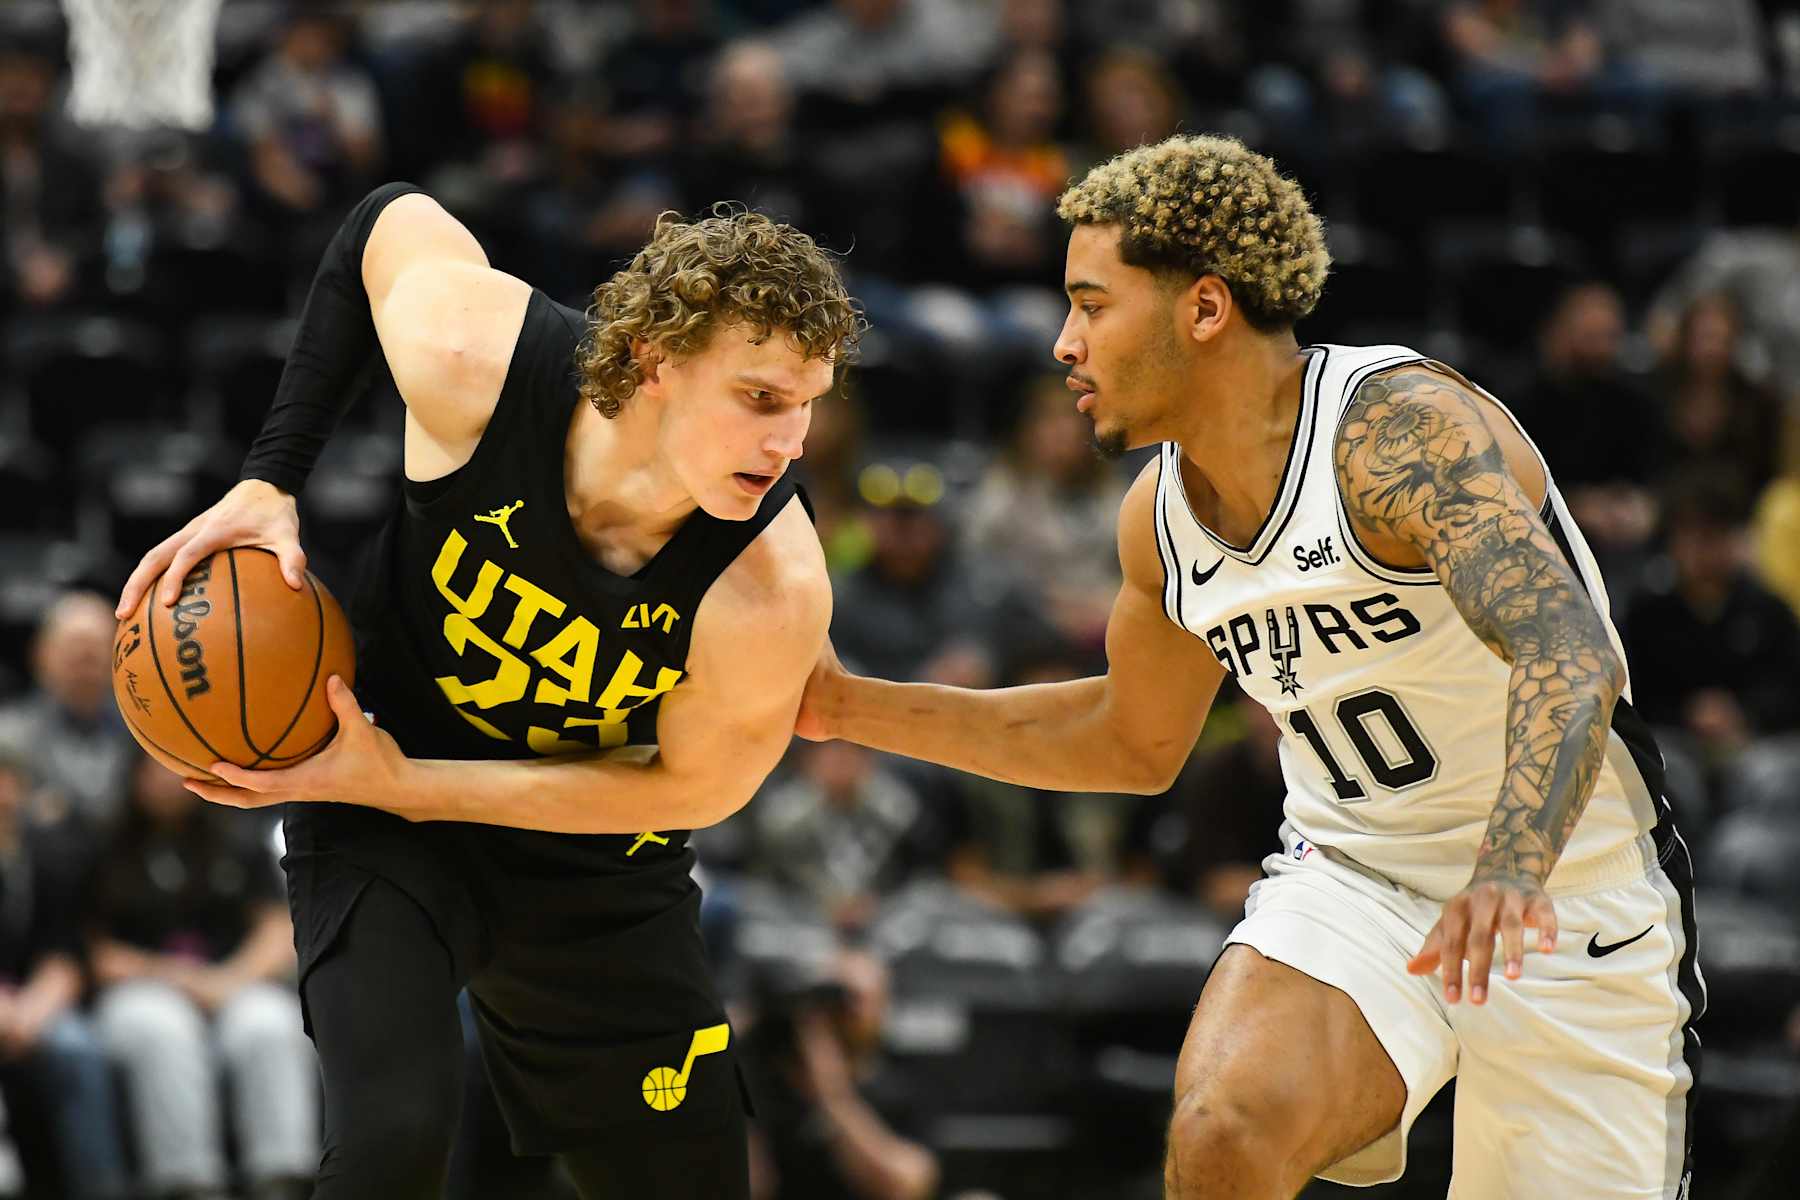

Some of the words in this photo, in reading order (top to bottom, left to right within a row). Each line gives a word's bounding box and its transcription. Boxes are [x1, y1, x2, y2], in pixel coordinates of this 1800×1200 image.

[1293, 537, 1341, 572] Self.
[431, 528, 683, 710] UTAH
[1206, 592, 1421, 698] SPURS
[1285, 685, 1441, 803] 10
